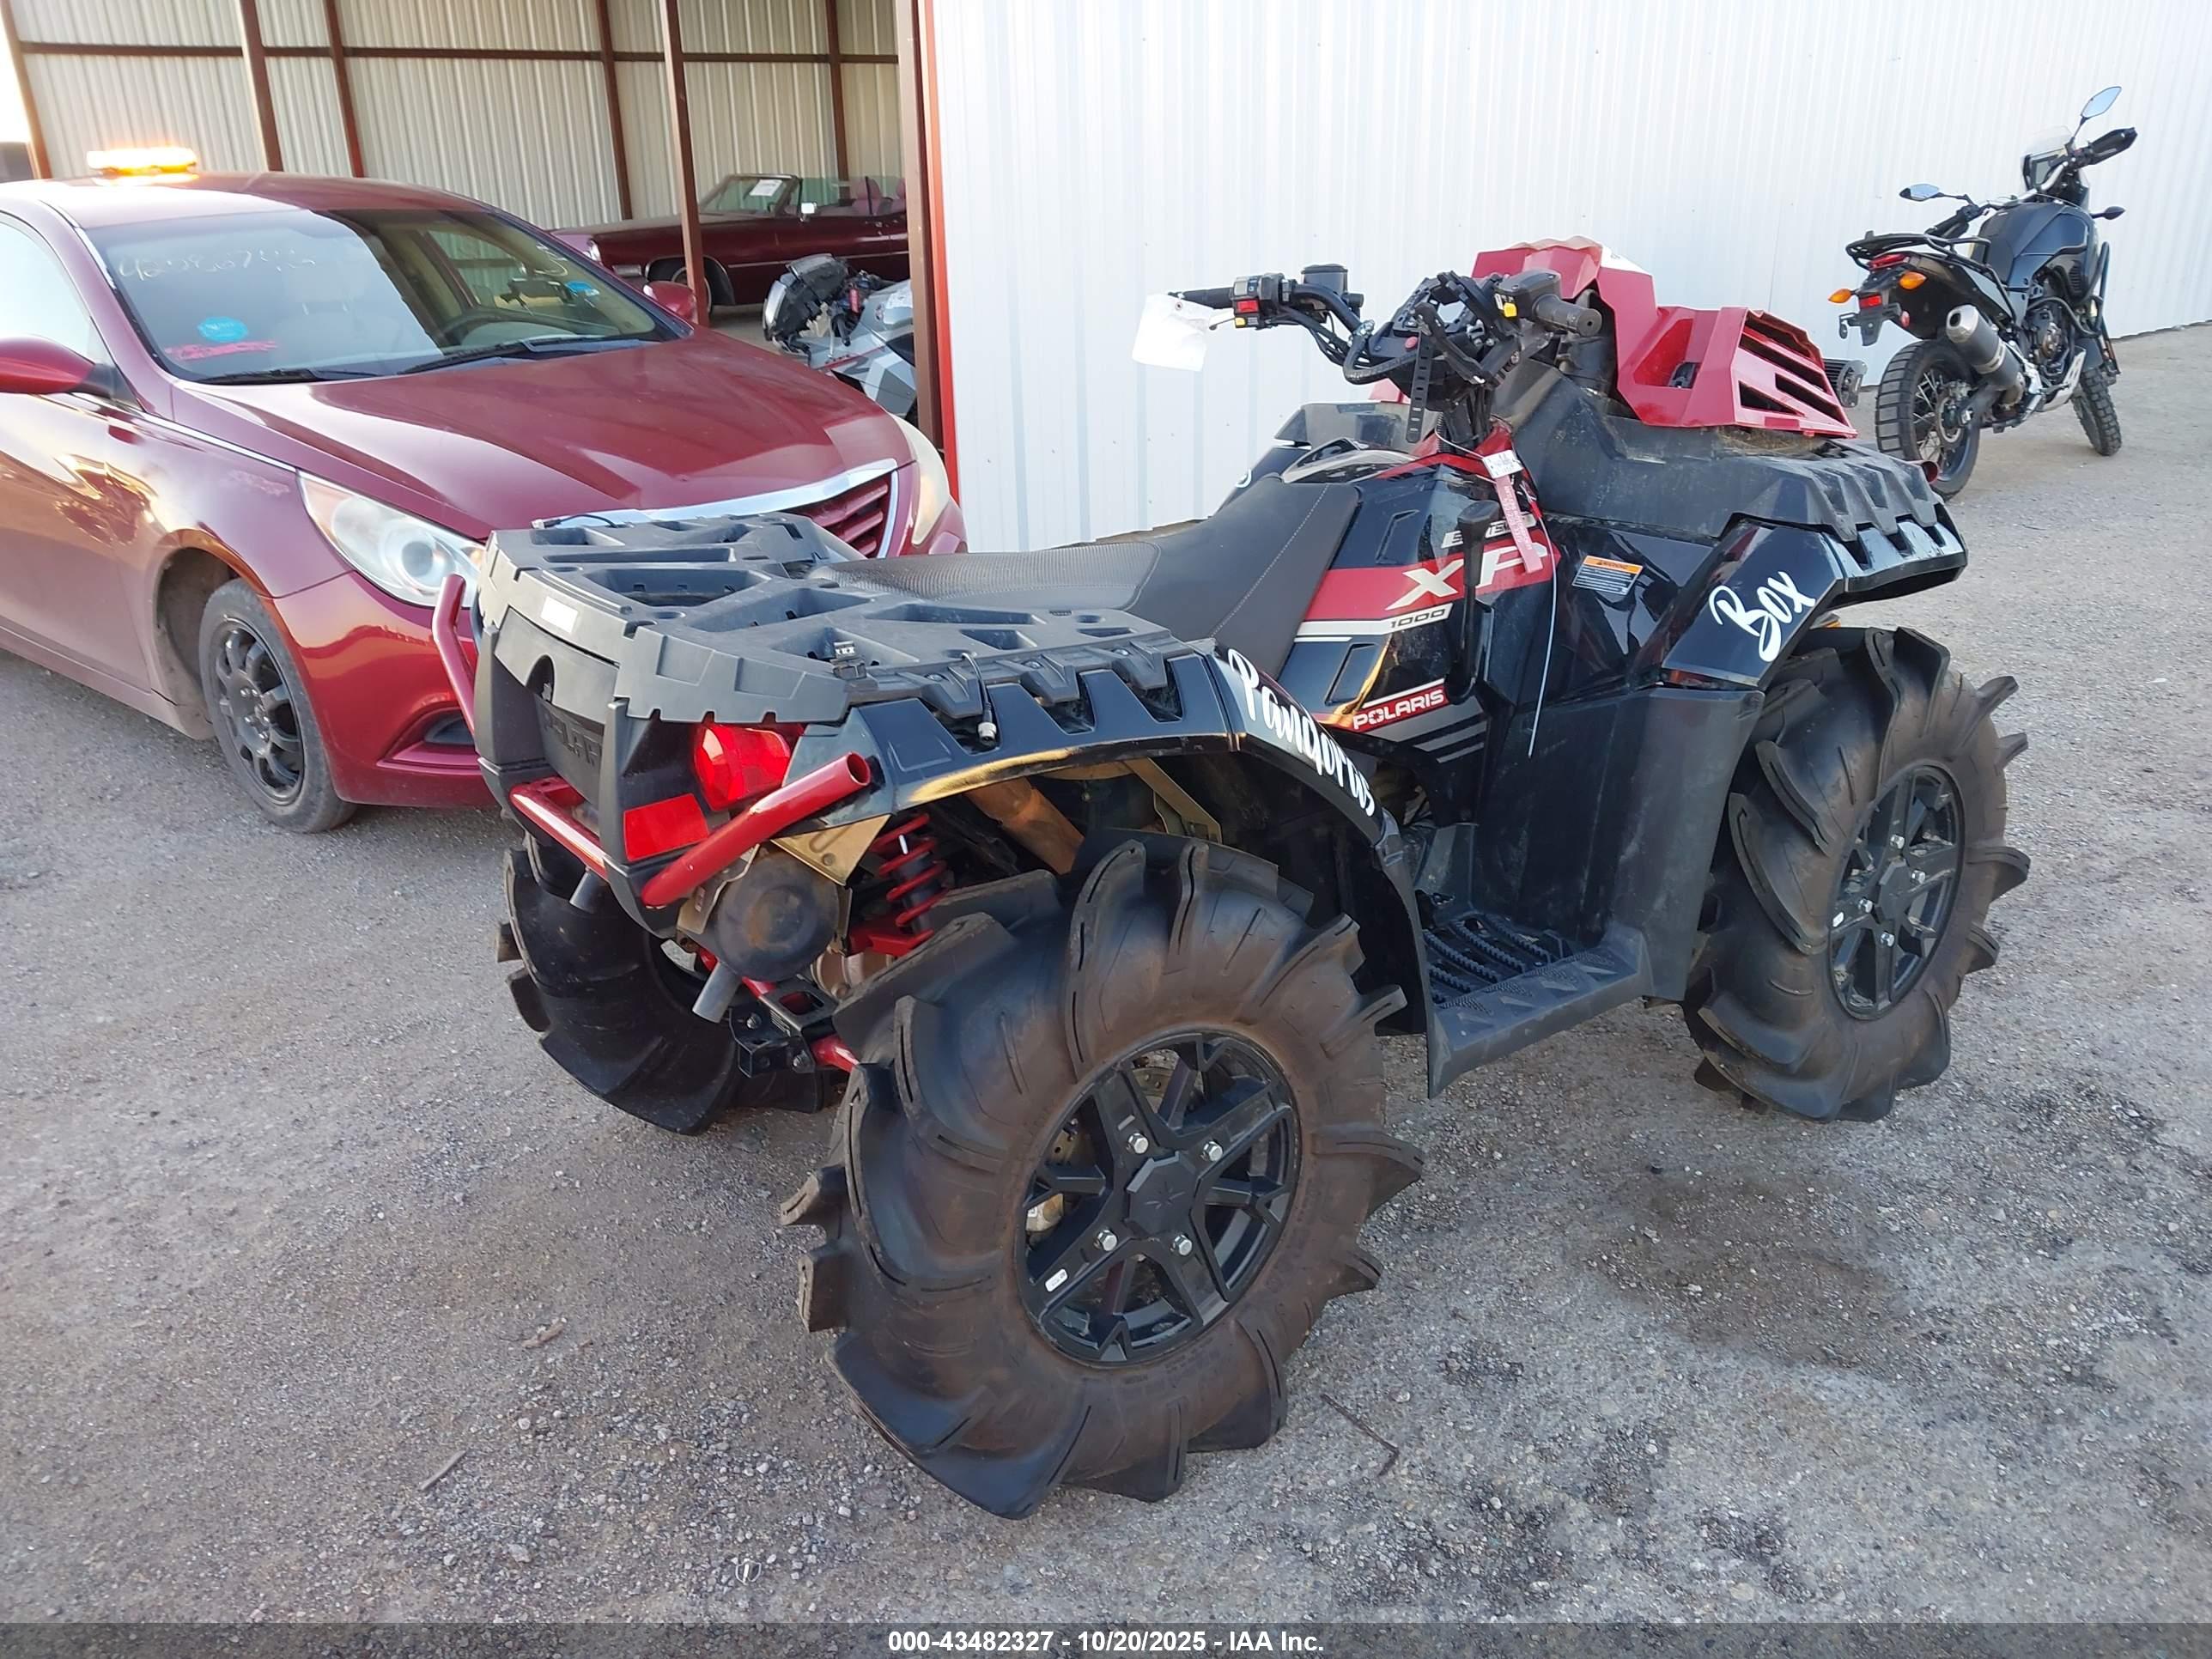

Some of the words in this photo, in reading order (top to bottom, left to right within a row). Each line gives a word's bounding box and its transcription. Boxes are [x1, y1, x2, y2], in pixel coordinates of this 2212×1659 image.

[1385, 543, 1548, 611] XP
[1391, 608, 1445, 629] 1000
[1709, 571, 1815, 662] Box
[1352, 689, 1444, 729] POLARIS
